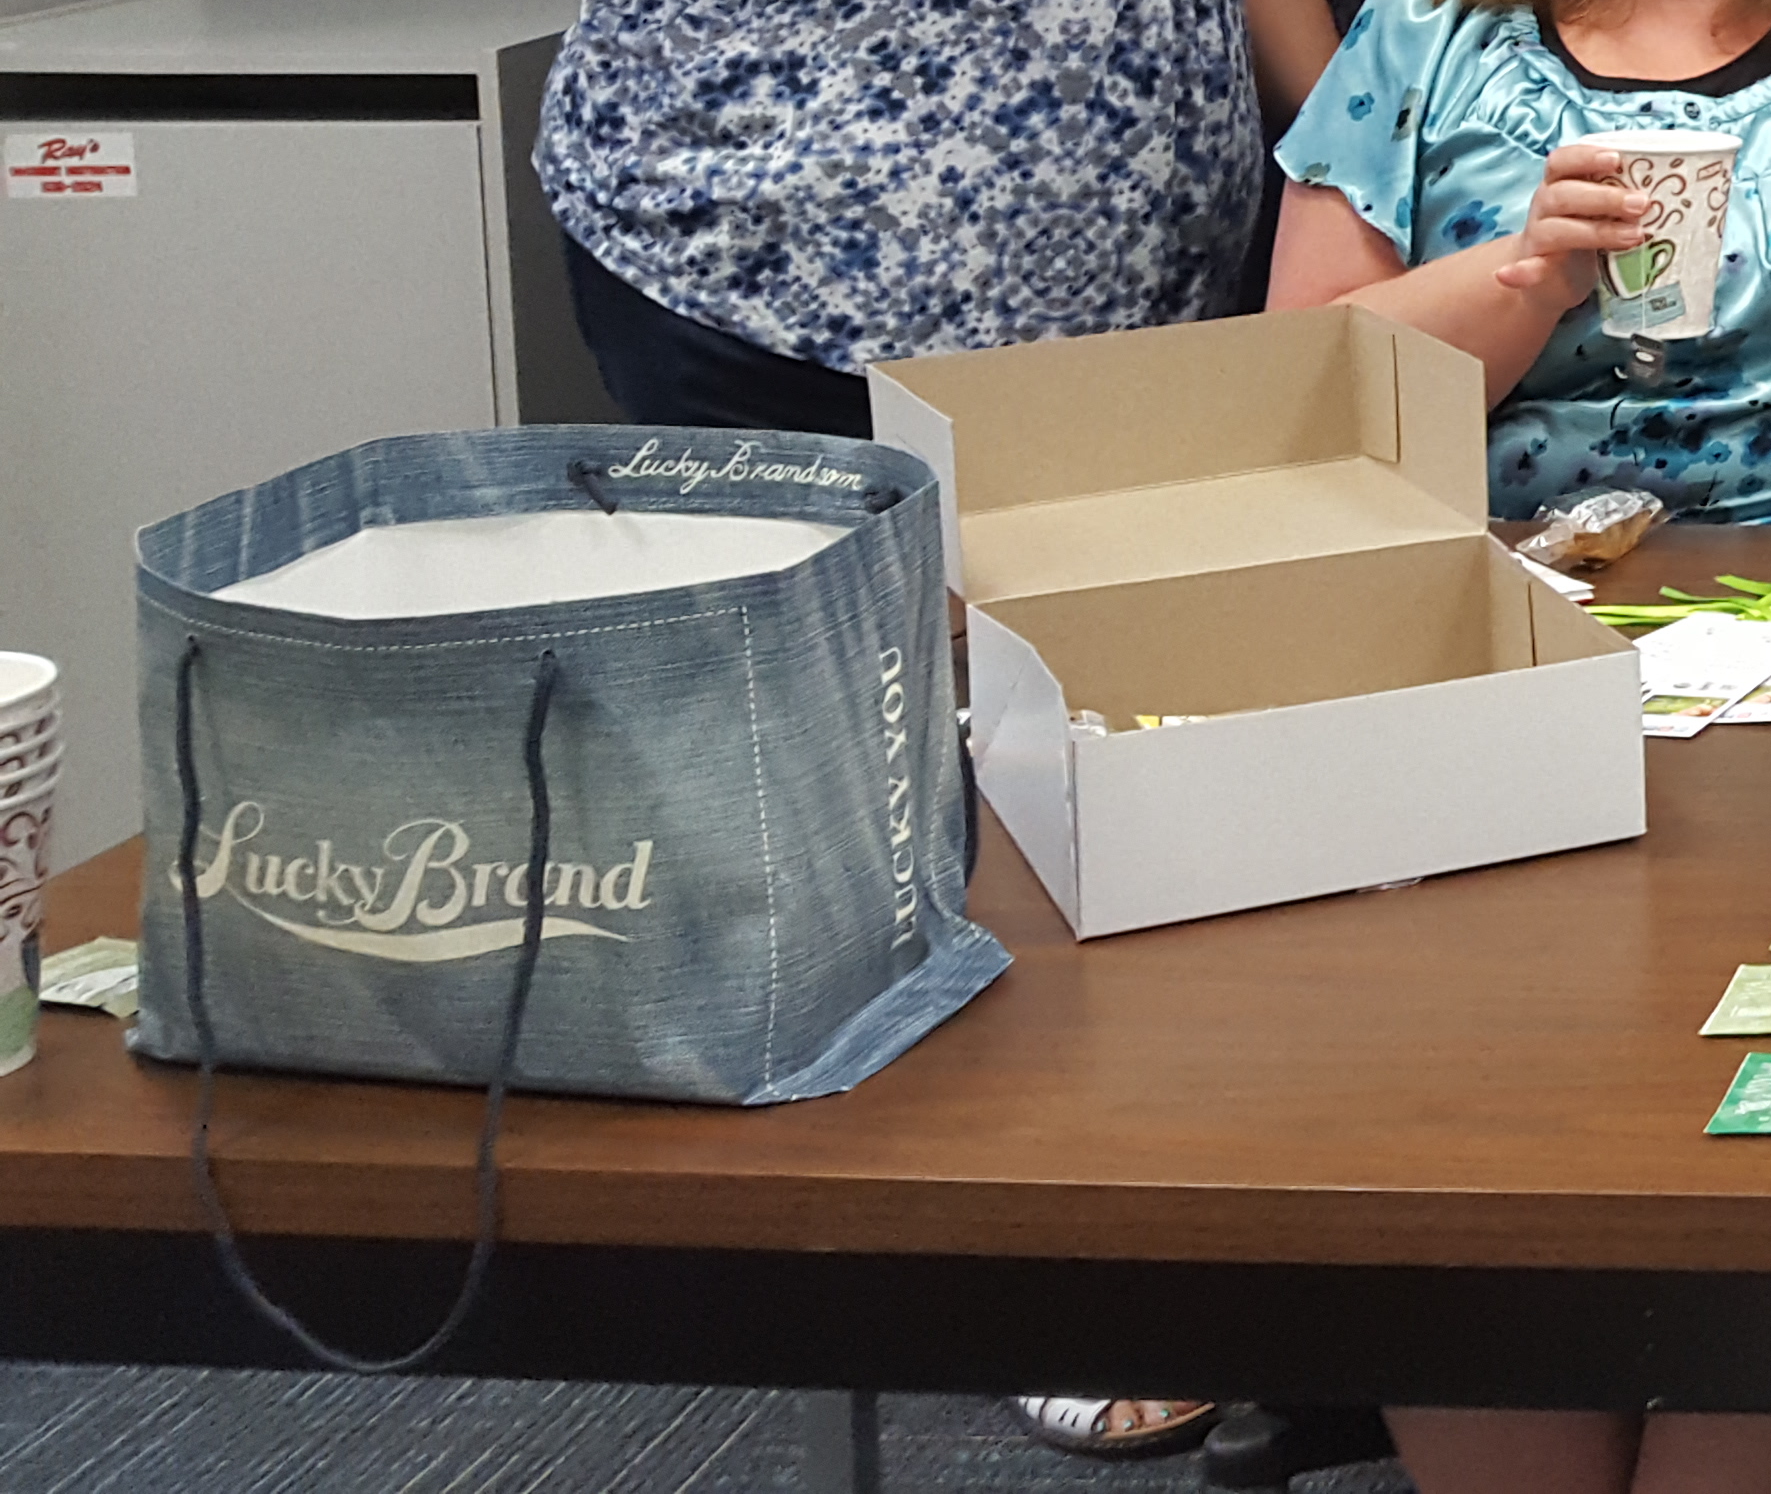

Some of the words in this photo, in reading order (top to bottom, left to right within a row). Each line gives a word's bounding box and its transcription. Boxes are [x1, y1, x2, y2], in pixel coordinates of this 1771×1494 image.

[879, 646, 908, 765] YOU
[167, 801, 384, 926] Lucky
[355, 818, 655, 932] Brand
[887, 774, 918, 951] LUCKY
